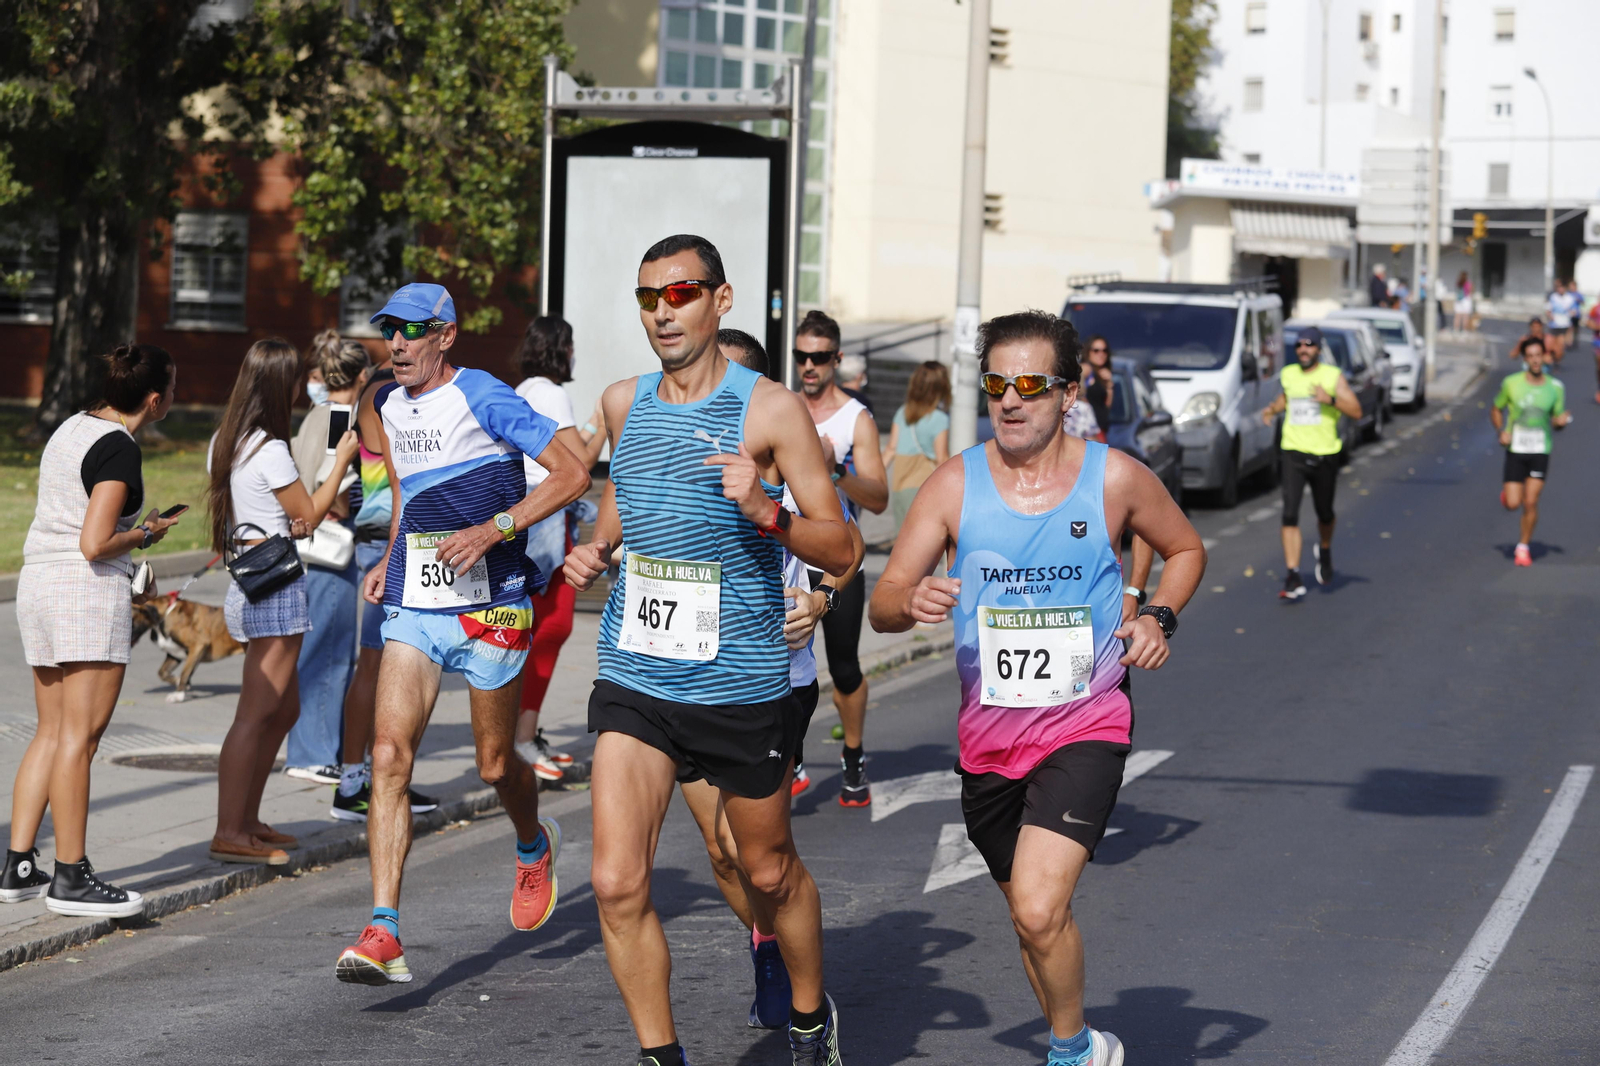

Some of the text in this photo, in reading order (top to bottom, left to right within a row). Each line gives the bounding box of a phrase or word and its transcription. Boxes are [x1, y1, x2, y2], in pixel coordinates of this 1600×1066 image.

[430, 428, 442, 438] LA
[394, 439, 442, 454] PALMERA
[421, 563, 455, 588] 530
[639, 560, 664, 578] VUELTA
[665, 565, 673, 579] A
[675, 565, 712, 581] HUELVA
[980, 565, 1083, 583] TARTESSOS
[1005, 584, 1052, 595] HUELVA
[484, 608, 518, 627] CLUB
[637, 596, 678, 631] 467
[995, 613, 1032, 628] VUELTA
[1035, 613, 1042, 627] A
[997, 648, 1051, 680] 672
